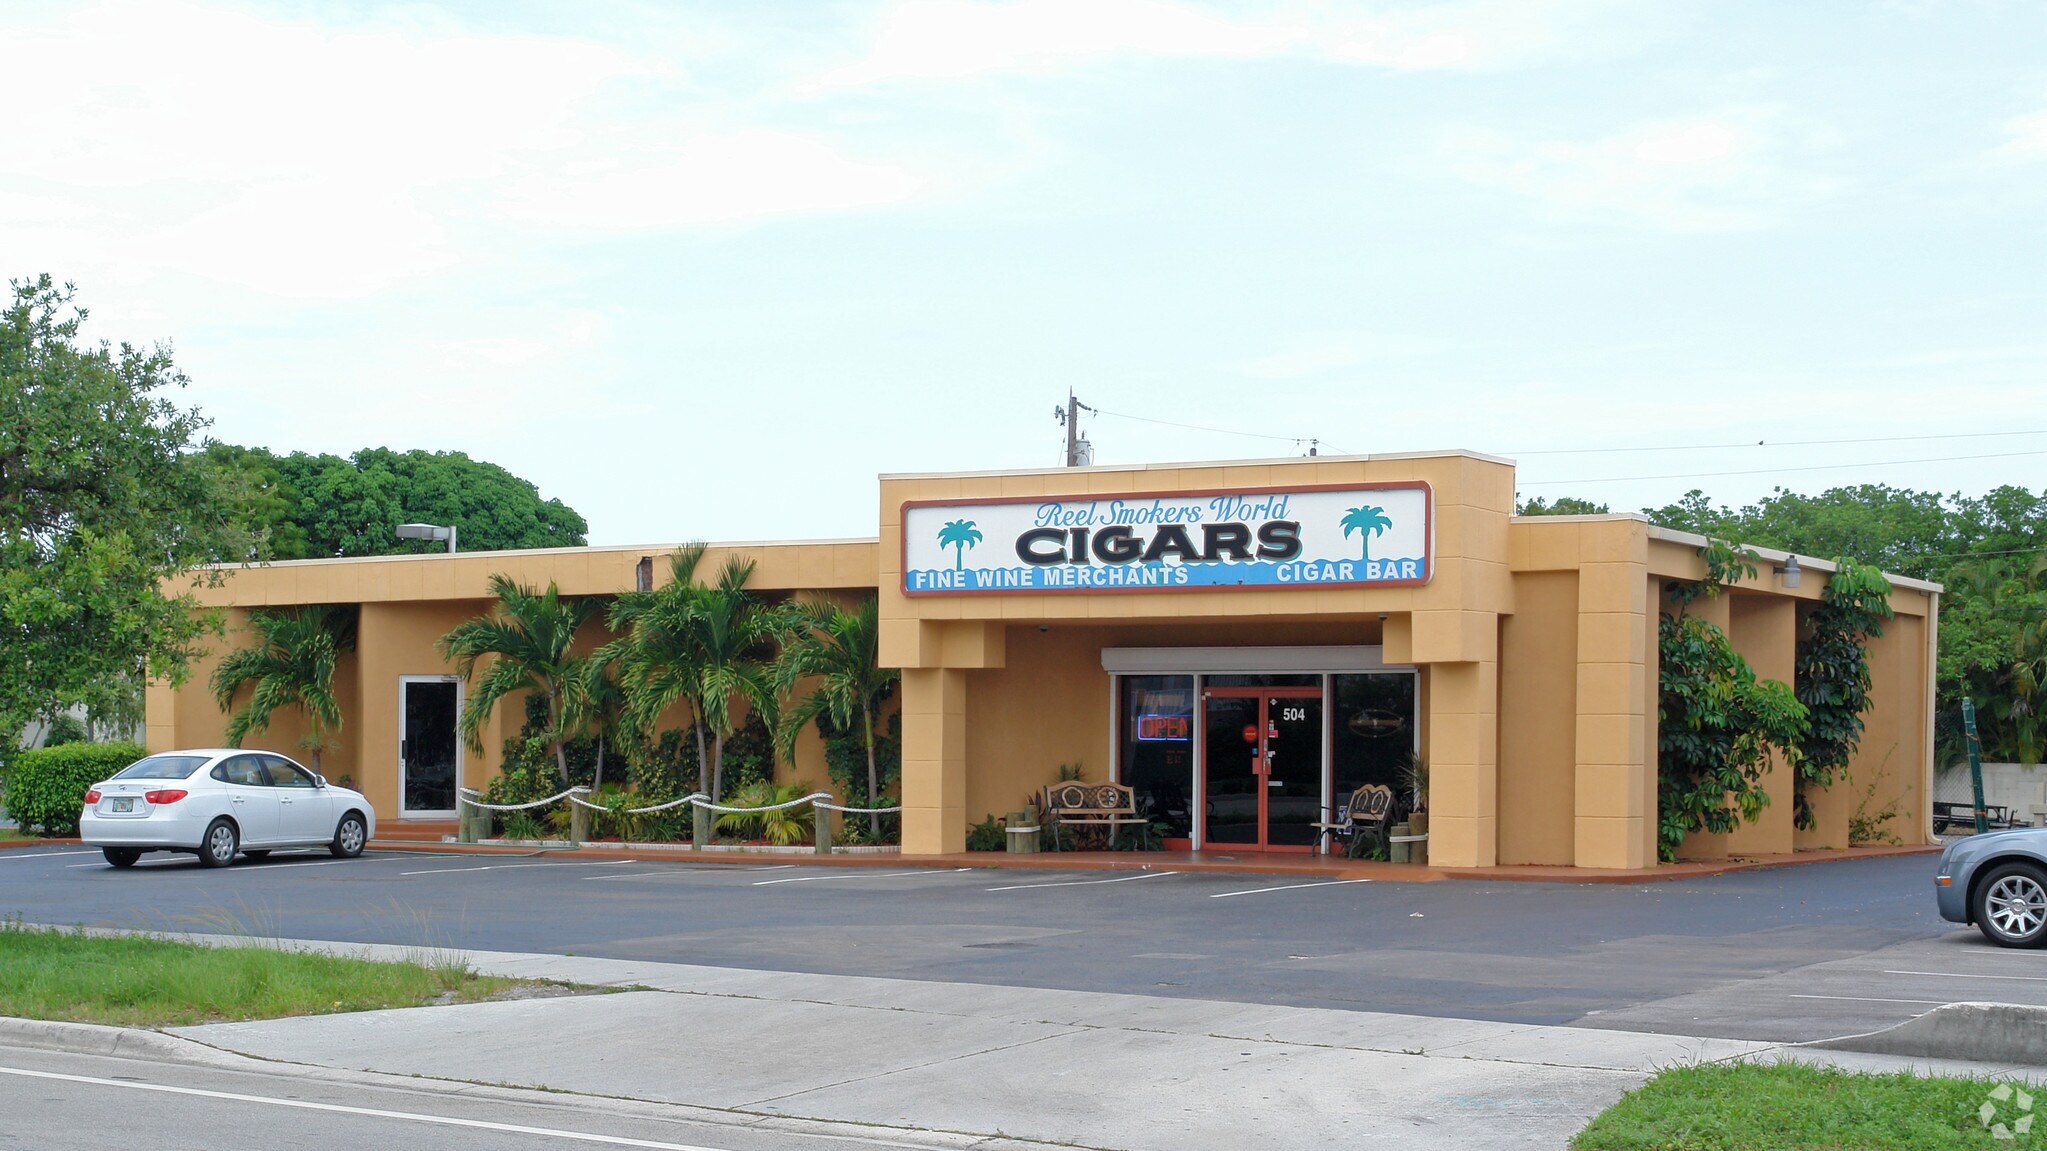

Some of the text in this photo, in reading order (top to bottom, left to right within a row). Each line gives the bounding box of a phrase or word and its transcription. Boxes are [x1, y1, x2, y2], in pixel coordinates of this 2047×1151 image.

[1034, 494, 1290, 527] Reel Smokers World
[1015, 520, 1303, 567] CIGARS
[915, 566, 1188, 589] FINE WINE MERCHANTS
[1276, 561, 1418, 582] CIGAR BAR
[1283, 708, 1305, 721] 504
